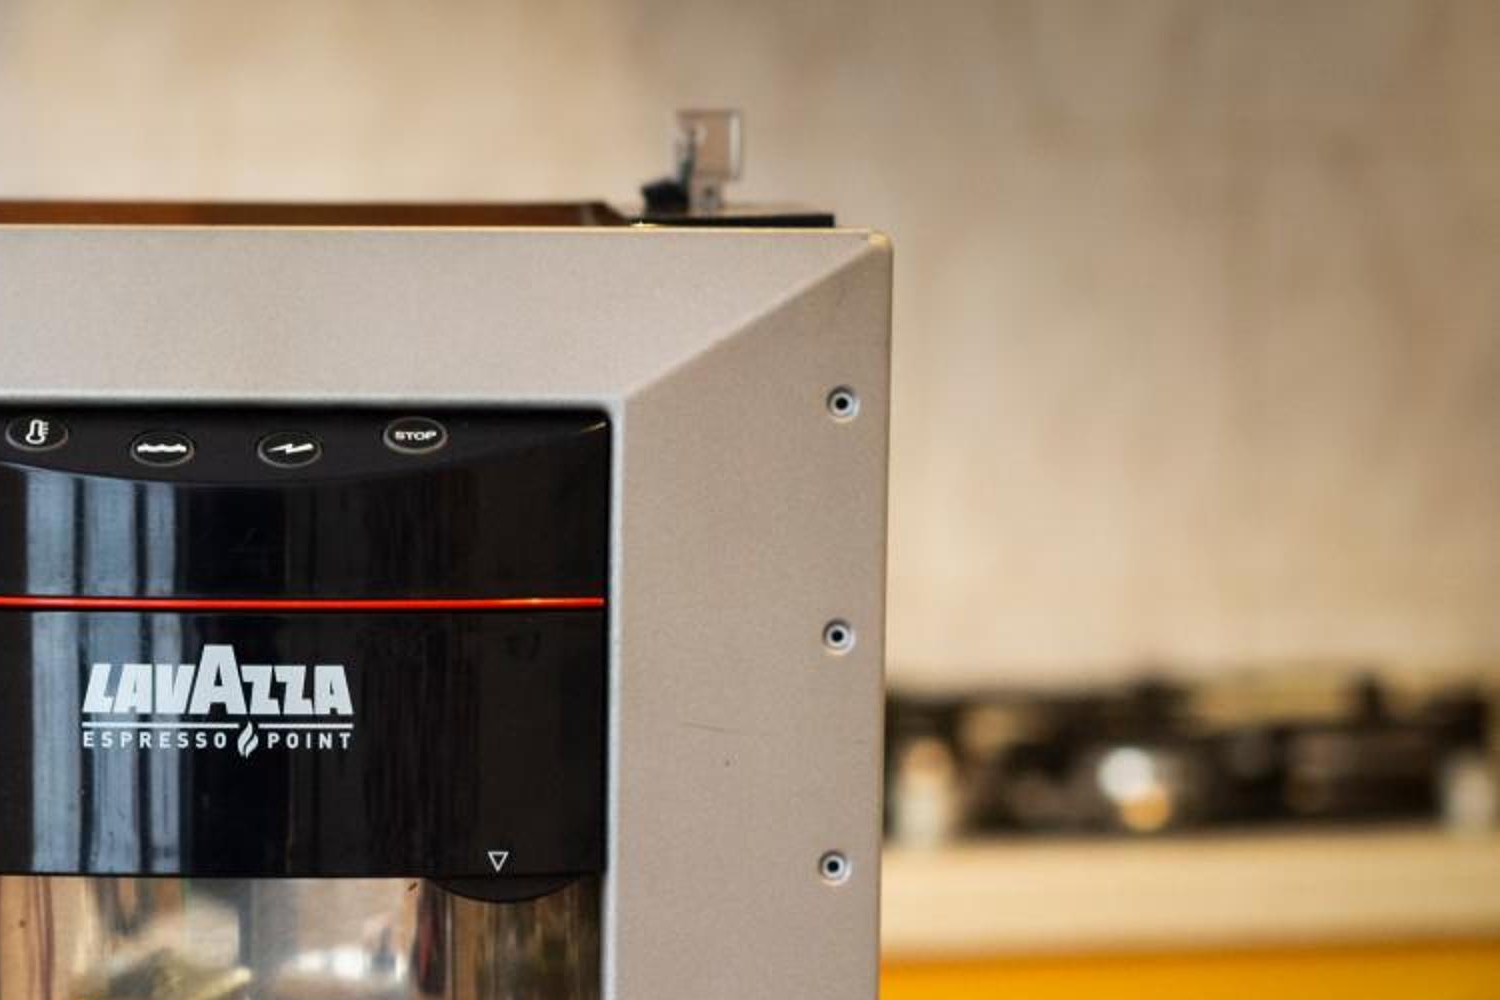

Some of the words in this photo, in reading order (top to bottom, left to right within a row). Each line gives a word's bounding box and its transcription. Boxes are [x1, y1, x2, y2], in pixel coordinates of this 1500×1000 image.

[394, 430, 438, 441] STOP
[82, 643, 354, 715] LAVAZZA
[82, 731, 228, 749] ESPRESSO
[267, 731, 352, 749] POINT
